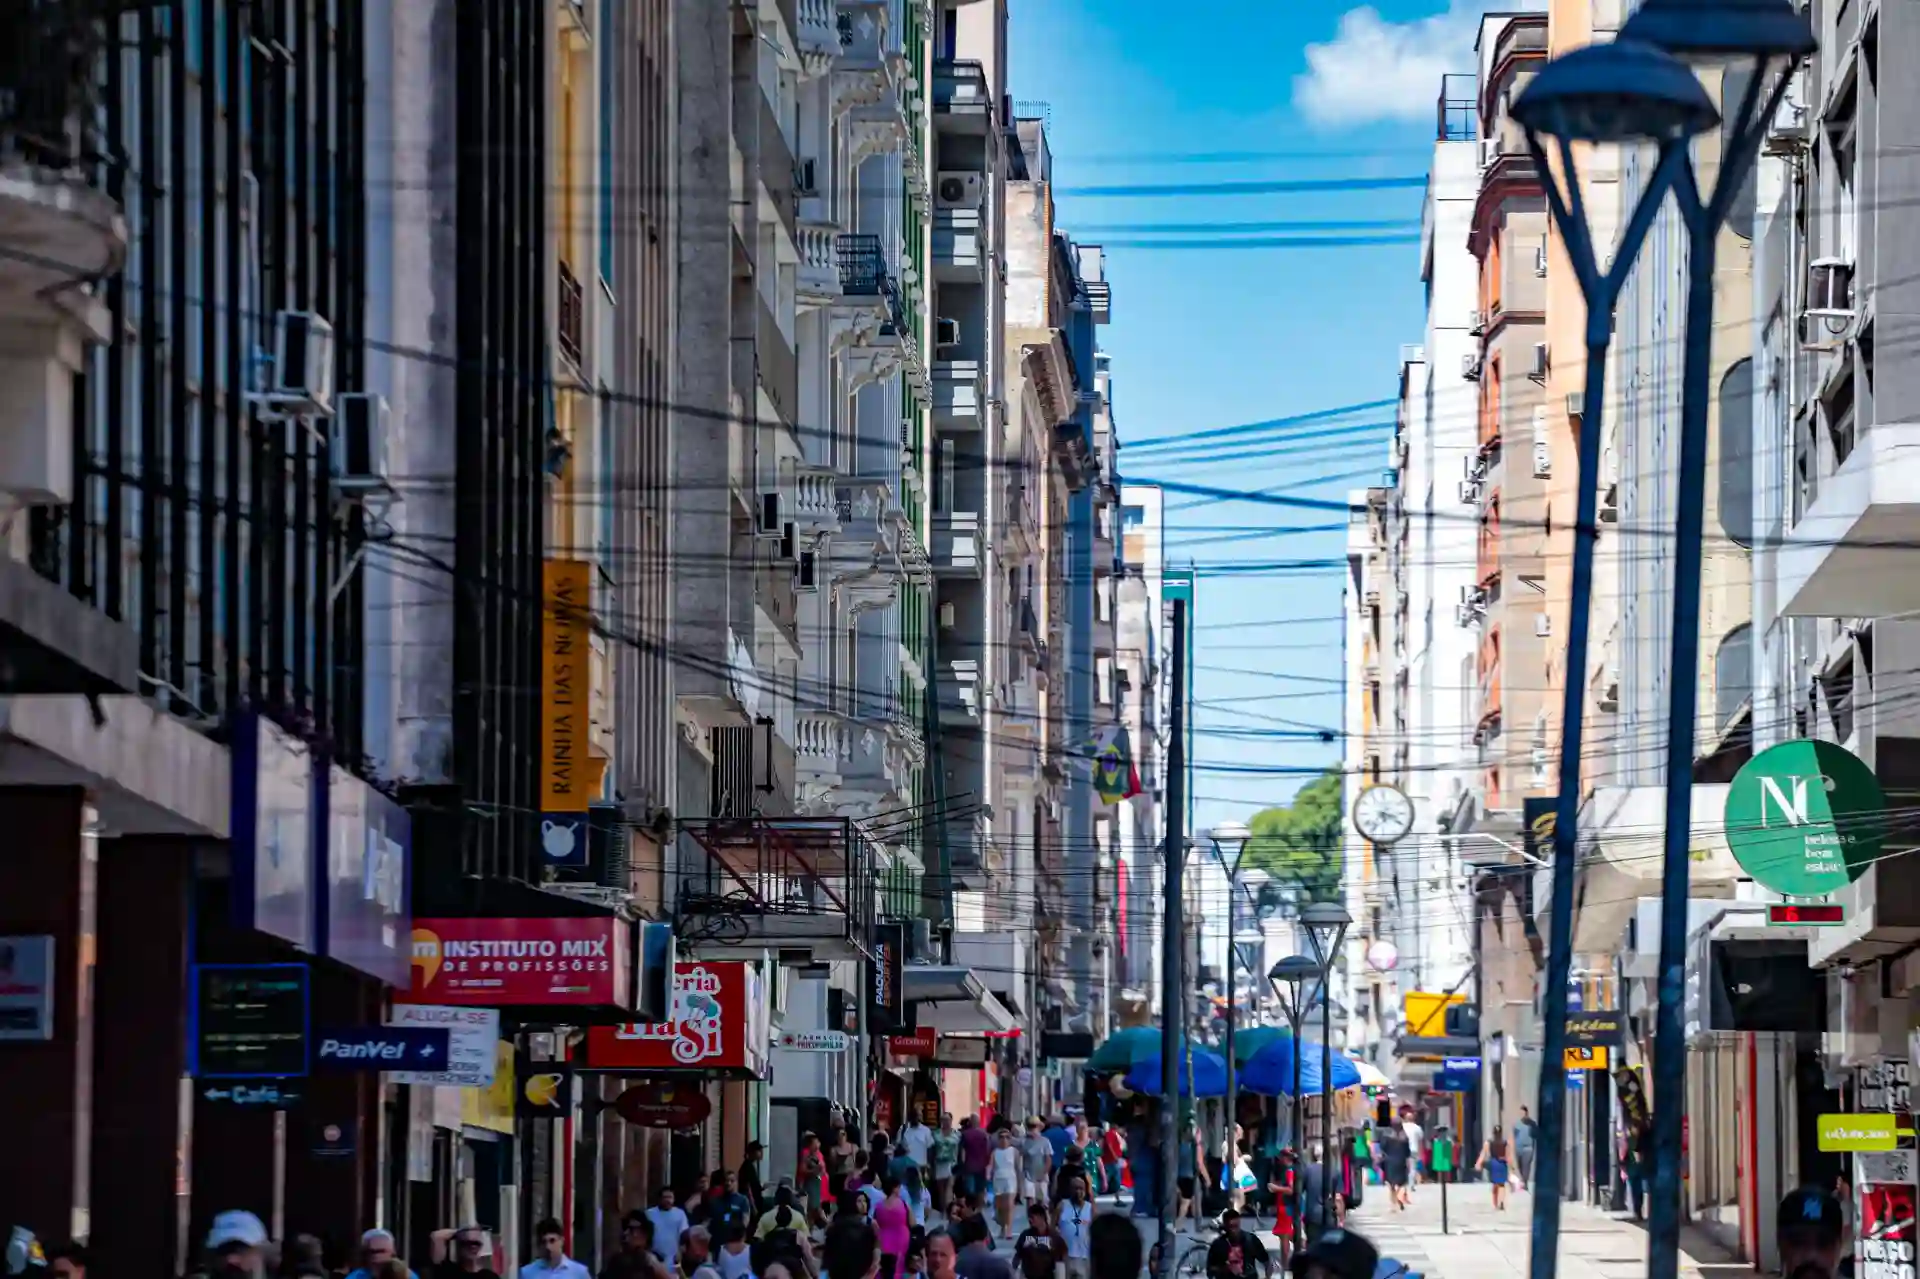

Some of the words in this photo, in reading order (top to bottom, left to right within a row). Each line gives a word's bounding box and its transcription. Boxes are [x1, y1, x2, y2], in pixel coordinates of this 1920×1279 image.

[552, 663, 572, 706] DAS
[552, 714, 572, 795] RAINHA
[443, 940, 556, 957] INSTITUTO
[561, 935, 608, 957] MIX
[443, 961, 469, 972] DE
[480, 959, 609, 972] PROFISSÕES
[402, 1009, 490, 1025] ALUGA-SE
